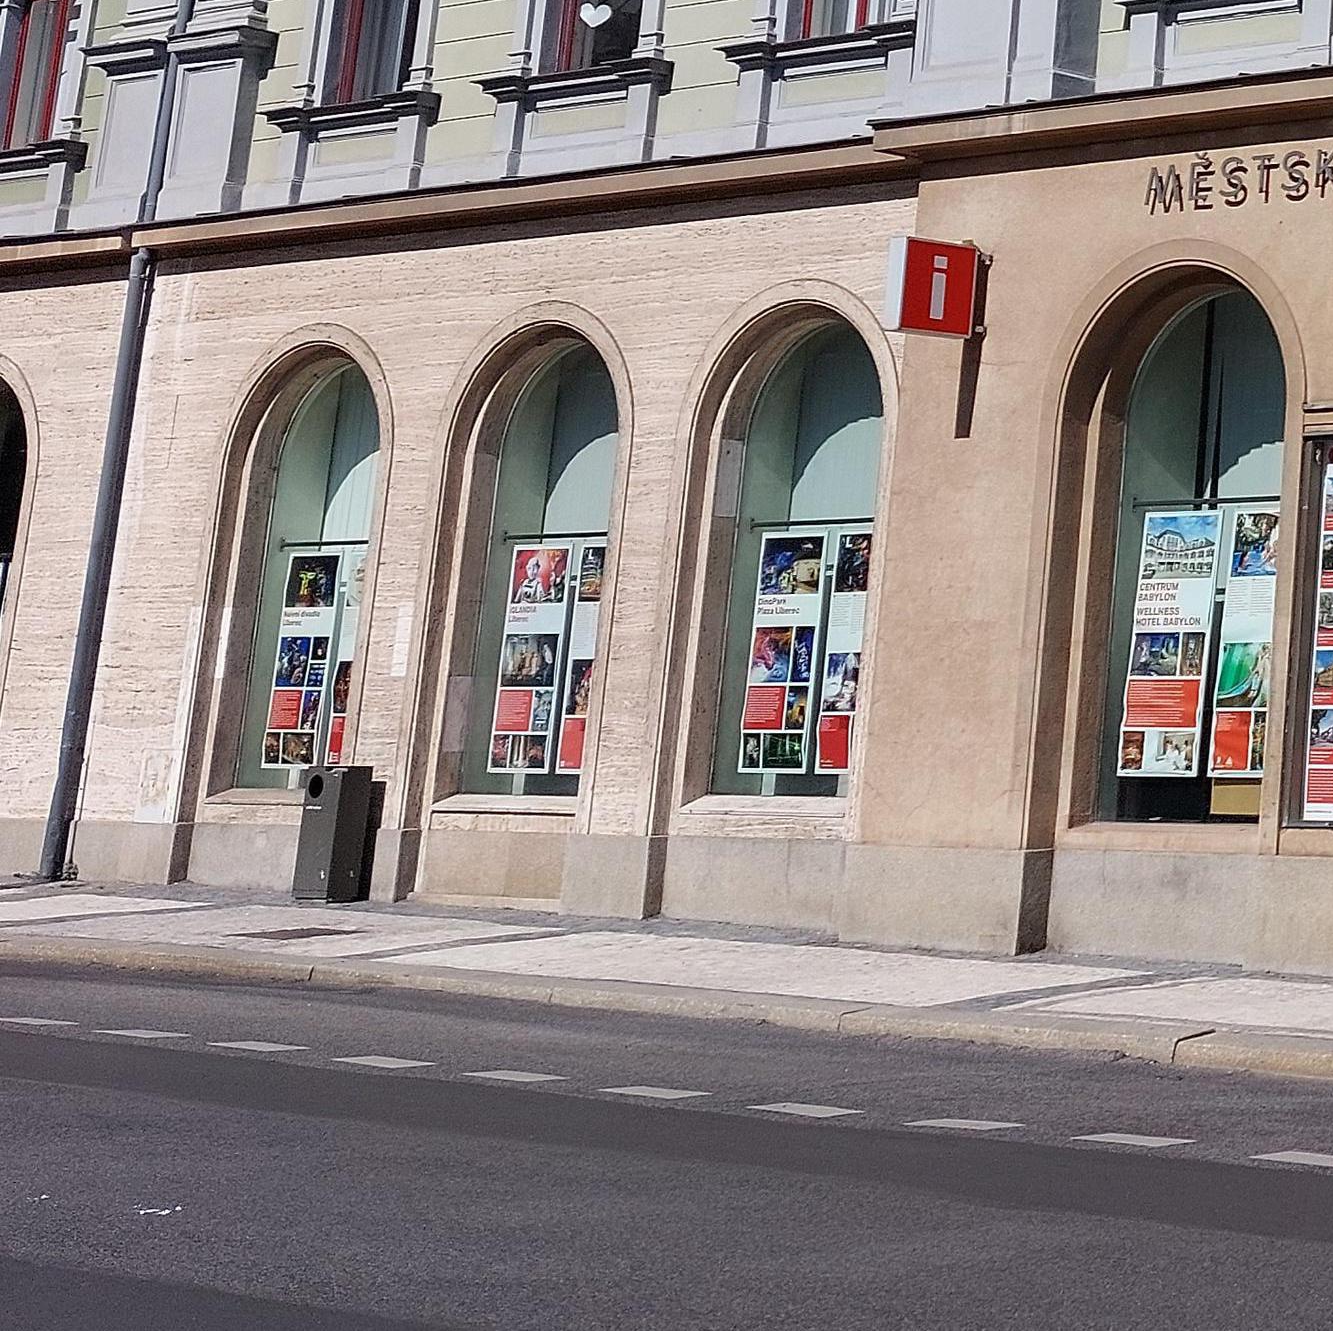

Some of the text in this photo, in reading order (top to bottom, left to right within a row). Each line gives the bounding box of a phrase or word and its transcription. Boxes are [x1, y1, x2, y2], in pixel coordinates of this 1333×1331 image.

[1140, 582, 1179, 591] CENTRUM
[1138, 592, 1176, 602] BABYLON
[1136, 606, 1180, 616] WELLNESS
[1136, 616, 1201, 626] HOTEL BABYLON
